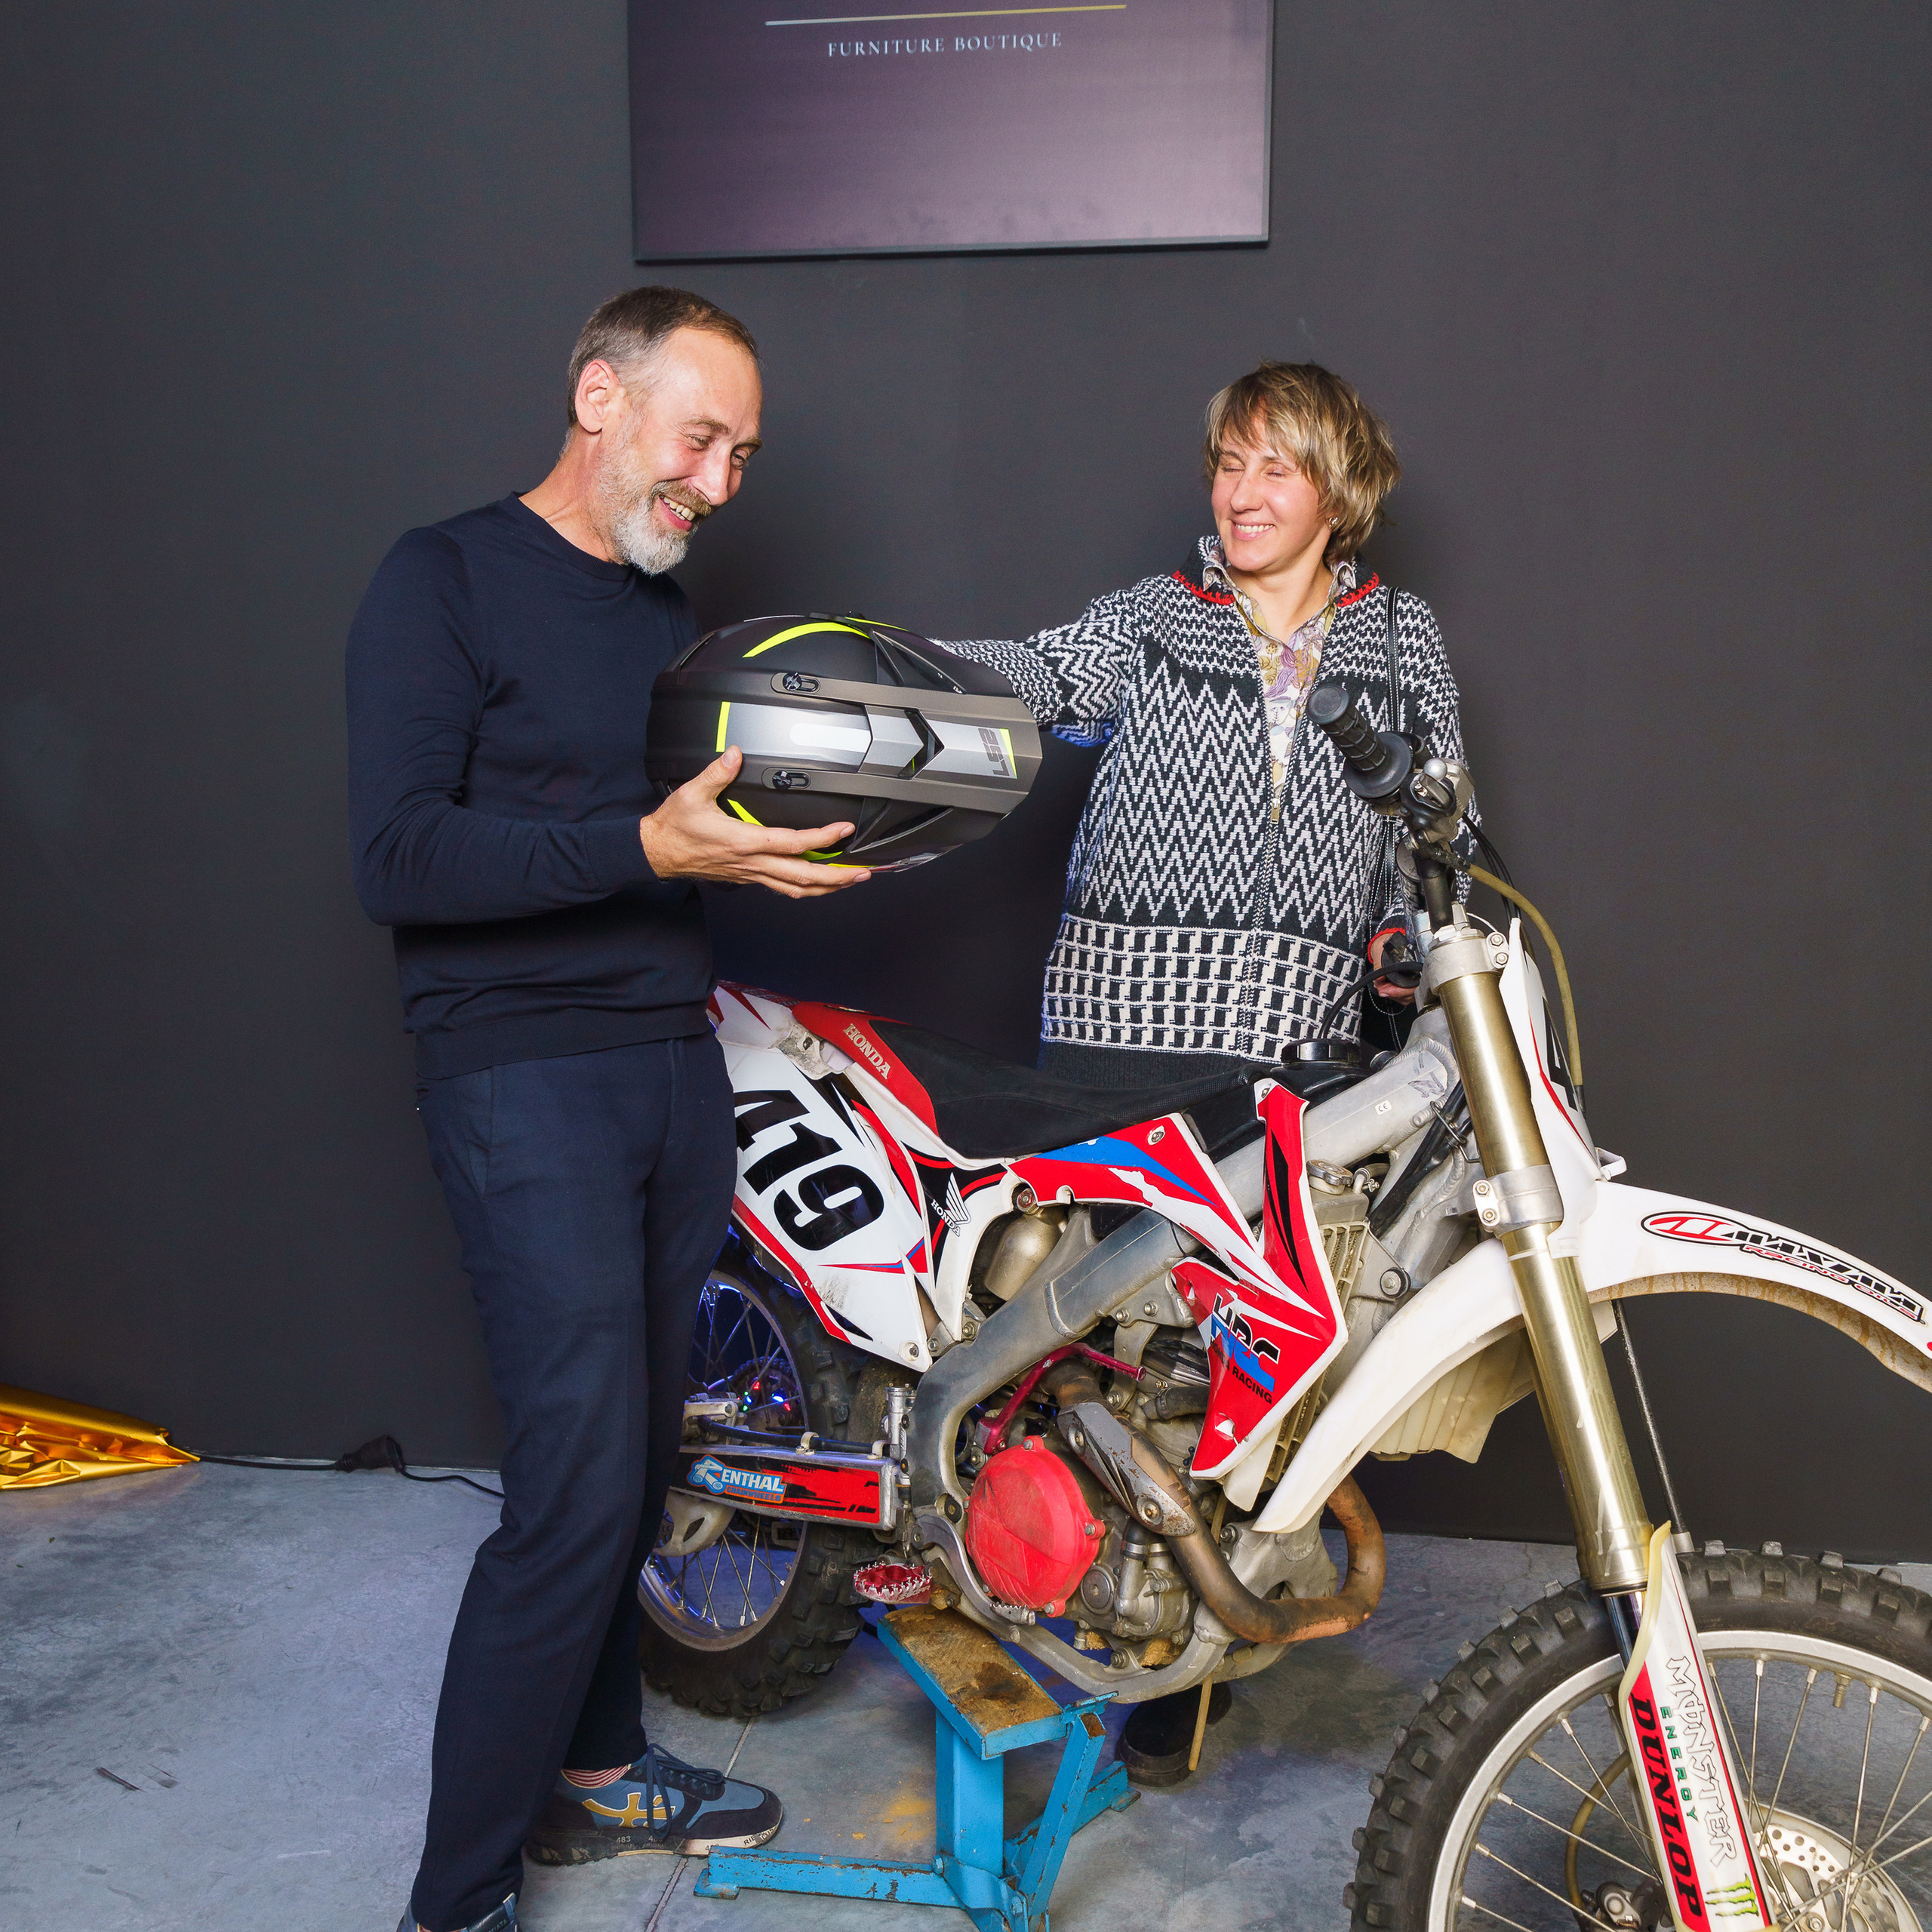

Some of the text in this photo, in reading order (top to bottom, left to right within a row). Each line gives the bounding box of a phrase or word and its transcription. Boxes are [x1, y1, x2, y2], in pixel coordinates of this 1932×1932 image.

[828, 32, 1062, 57] FURNITURE BOUTIQUE
[978, 728, 1010, 776] LS2
[843, 1023, 891, 1079] HONDA
[931, 1198, 961, 1237] HONDA
[1210, 1335, 1272, 1404] HONDA RACING
[693, 1459, 783, 1493] RENTHAL
[726, 1486, 782, 1502] CHAINWHEELS
[1660, 1706, 1699, 1823] ENERGY
[1666, 1655, 1737, 1868] MONSTER
[1630, 1693, 1702, 1918] DUNLOP
[616, 1835, 631, 1844] 483
